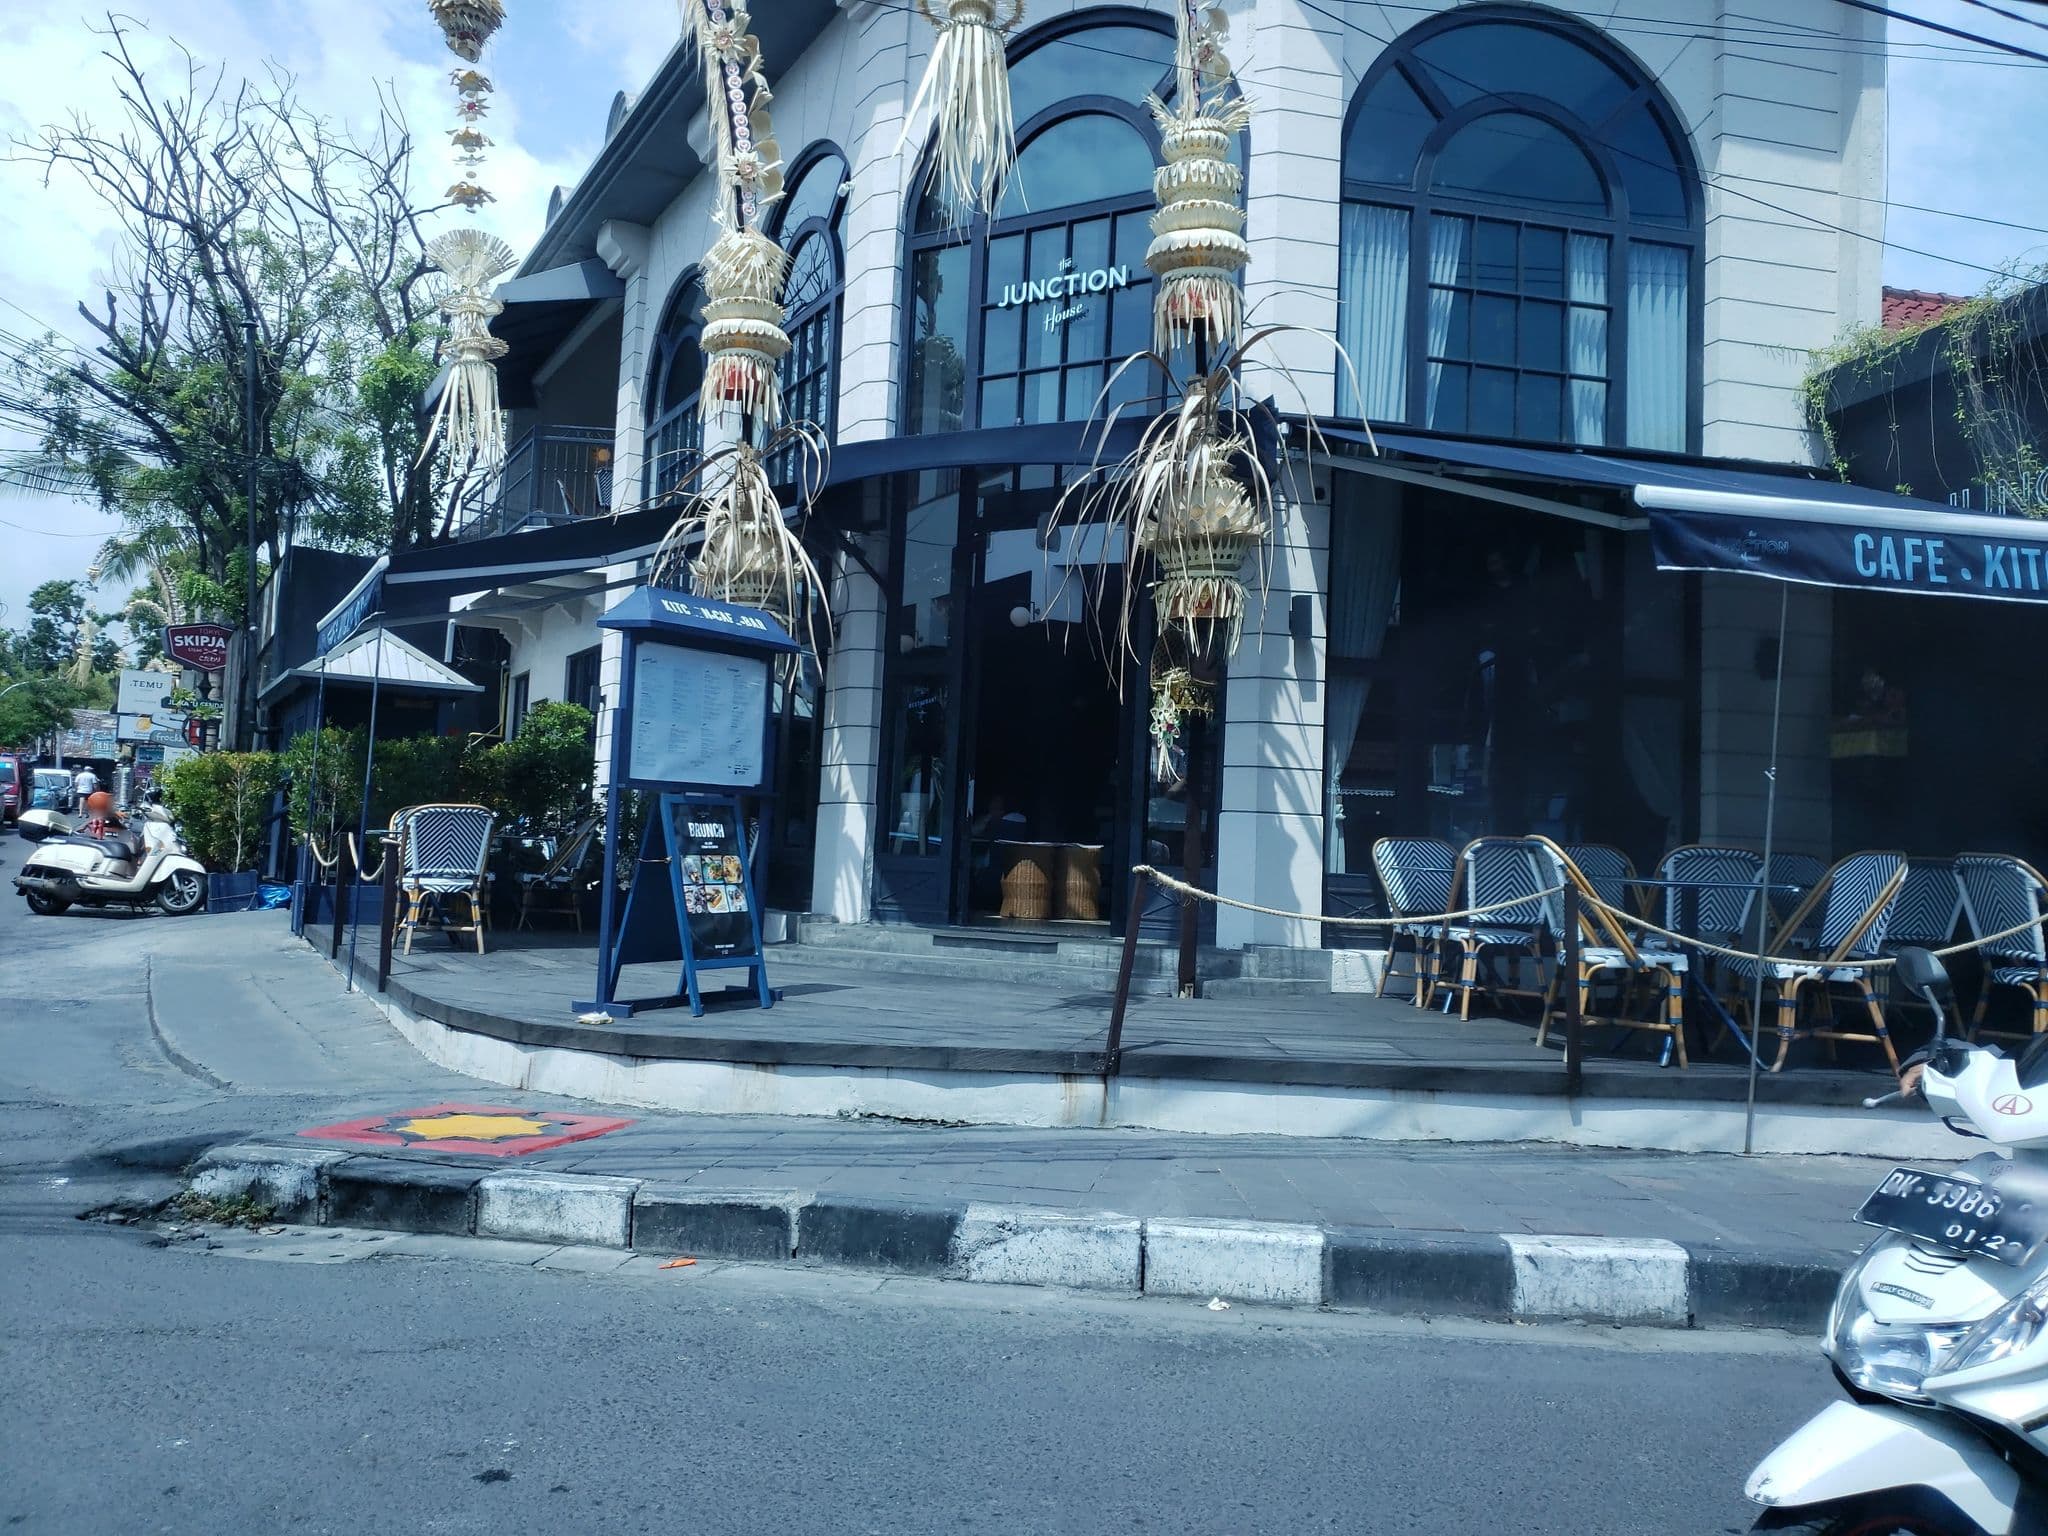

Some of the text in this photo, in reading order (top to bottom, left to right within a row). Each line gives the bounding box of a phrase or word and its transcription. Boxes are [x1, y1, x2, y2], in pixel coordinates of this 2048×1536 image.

[1058, 257, 1073, 272] the
[997, 264, 1127, 308] JUNCTION
[1043, 303, 1083, 333] House
[1853, 533, 2048, 591] CAFE KIT
[661, 598, 712, 620] KITCN
[132, 680, 164, 690] TEMU
[687, 822, 725, 839] BRUNCH
